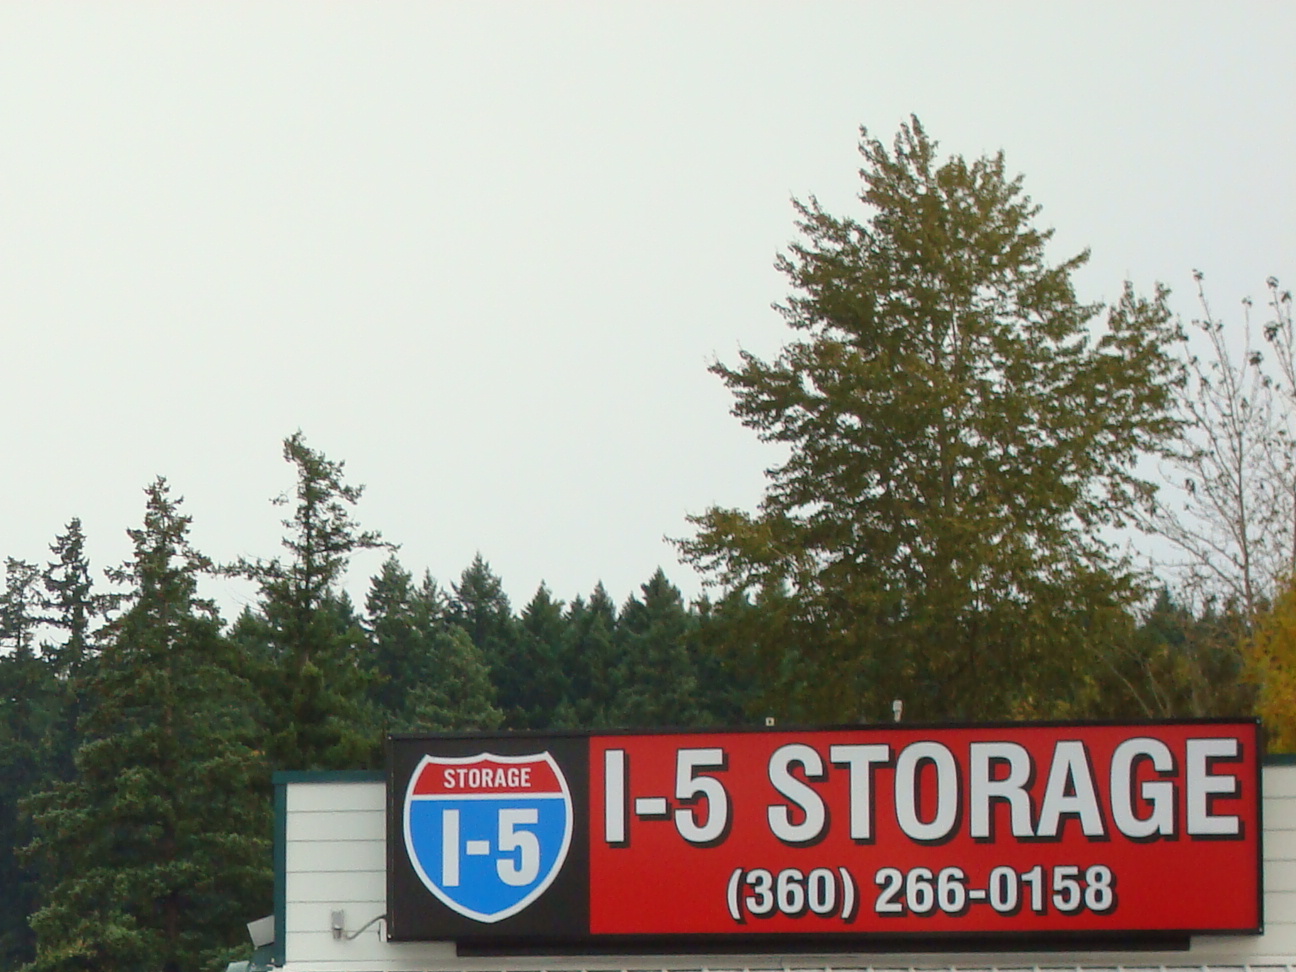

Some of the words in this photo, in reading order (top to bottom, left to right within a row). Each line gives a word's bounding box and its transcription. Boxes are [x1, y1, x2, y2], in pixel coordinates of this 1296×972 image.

[444, 768, 531, 788] STORAGE
[605, 749, 727, 842] I-5
[769, 738, 1239, 841] STORAGE
[442, 808, 540, 887] I-5
[727, 867, 854, 920] (360)
[875, 865, 1112, 914] 266-0158
